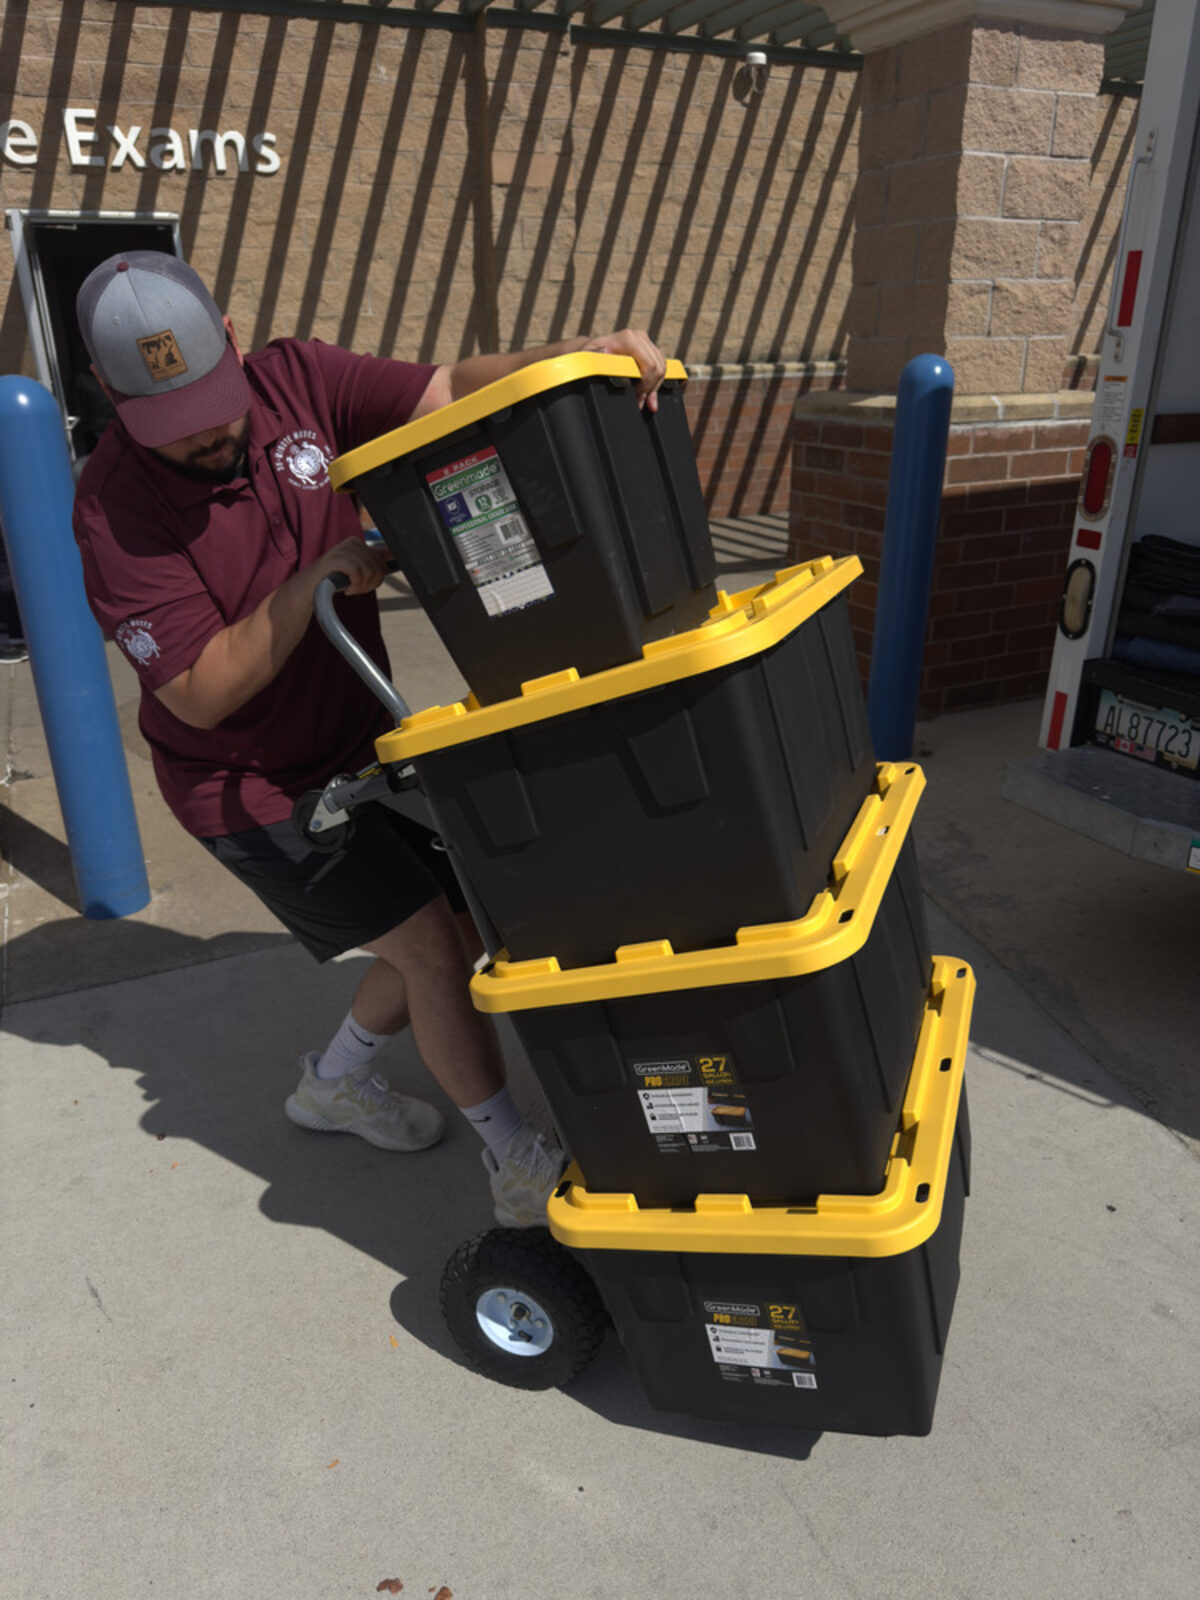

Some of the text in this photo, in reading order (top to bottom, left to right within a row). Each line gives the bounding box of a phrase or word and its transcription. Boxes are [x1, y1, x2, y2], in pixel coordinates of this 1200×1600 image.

[0, 108, 281, 174] e Exams
[452, 456, 478, 472] PACK
[434, 463, 497, 498] Greenmade
[1103, 704, 1192, 759] AL87723
[699, 1056, 727, 1073] 27
[768, 1305, 796, 1320] 27
